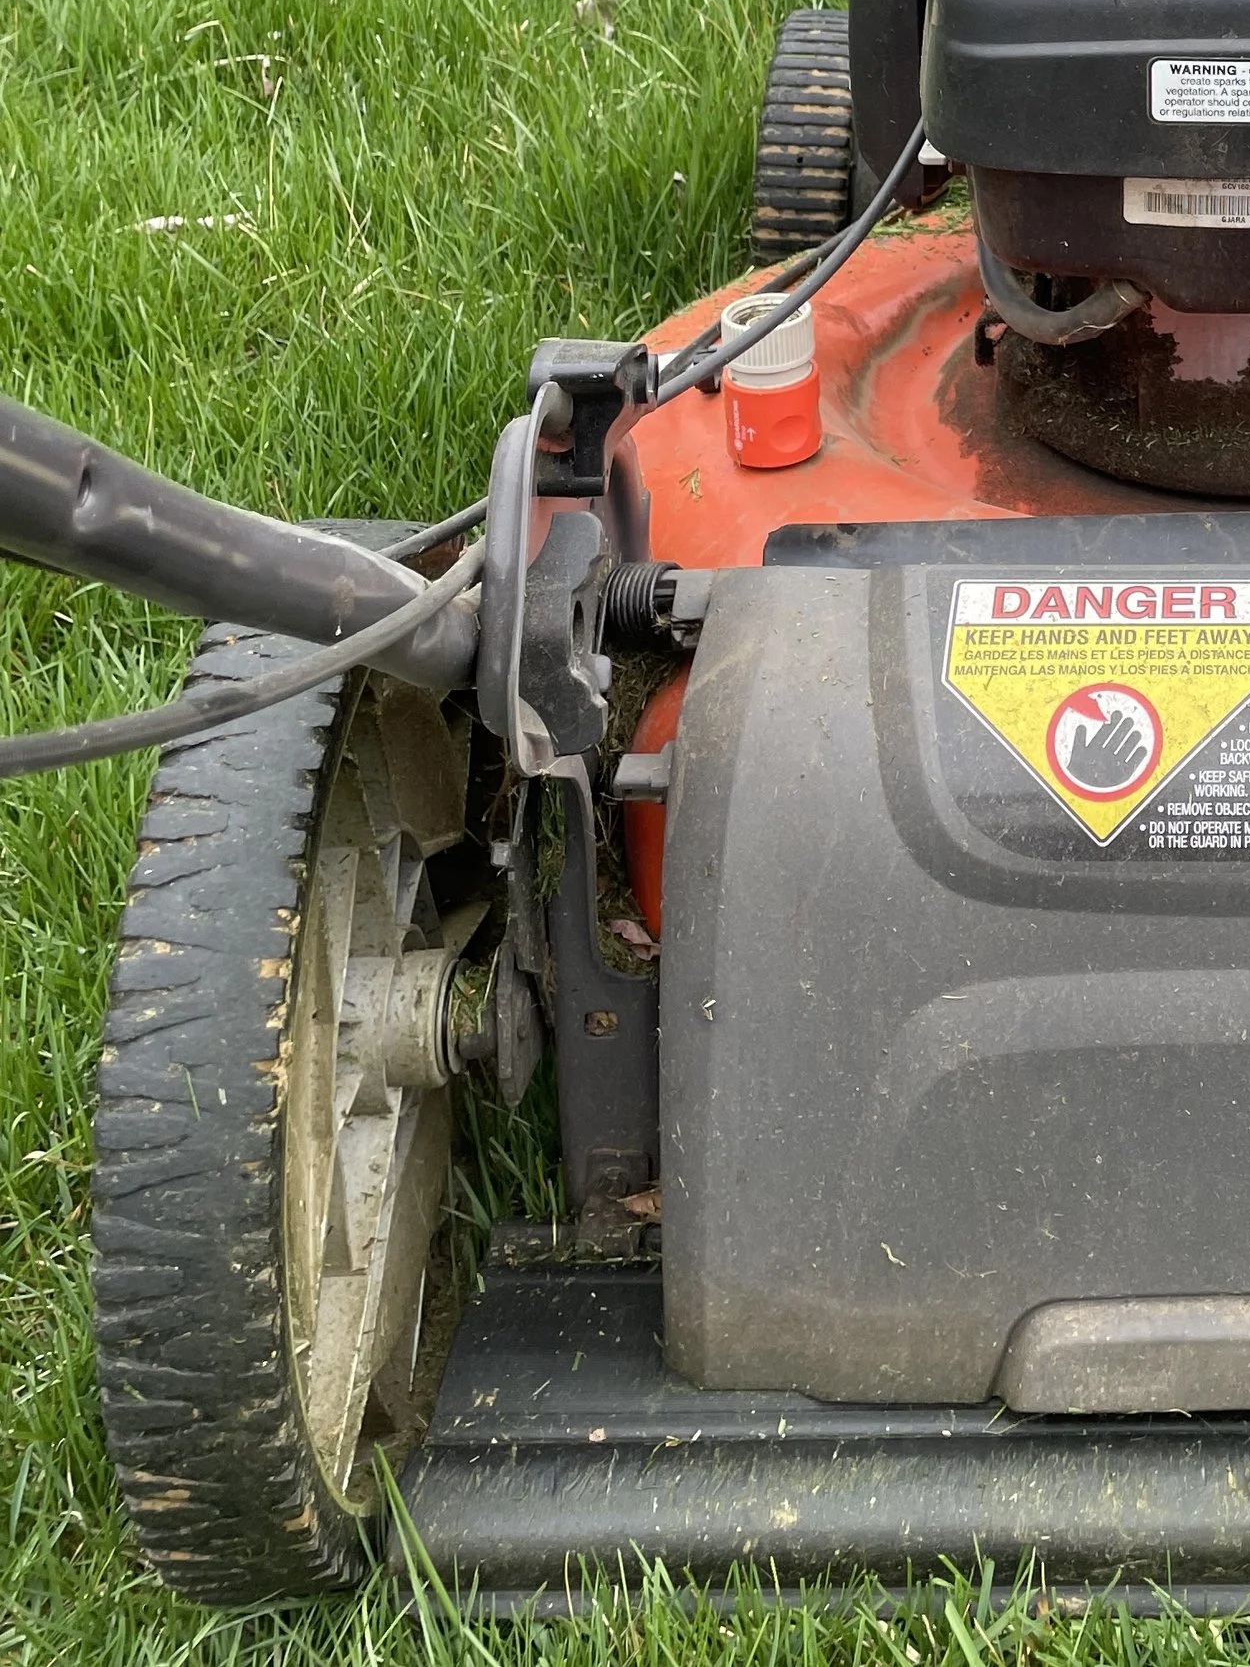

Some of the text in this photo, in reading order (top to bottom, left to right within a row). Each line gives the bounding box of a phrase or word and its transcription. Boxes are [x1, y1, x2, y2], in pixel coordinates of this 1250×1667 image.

[1170, 64, 1237, 76] WARNING
[1180, 78, 1211, 86] create
[1214, 77, 1246, 87] sparks
[1166, 88, 1218, 98] vegetation.
[1220, 88, 1228, 96] A
[1164, 98, 1205, 107] operator
[1208, 98, 1240, 107] should
[1172, 108, 1225, 118] regulations
[991, 586, 1237, 619] DANGER
[965, 629, 1014, 646] KEEP
[1020, 629, 1089, 646] HANDS
[1096, 629, 1137, 646] AND
[1144, 629, 1189, 646] FEET
[964, 650, 1017, 660] GARDEZ
[1020, 650, 1044, 660] LES
[1047, 650, 1088, 660] MAINS
[1091, 650, 1107, 660] ET
[1110, 650, 1134, 660] LES
[1138, 650, 1175, 660] PIEDS
[954, 665, 1027, 676] MANTENGA
[1030, 665, 1056, 676] LAS
[1058, 665, 1105, 676] MANOS
[1108, 665, 1118, 676] Y
[1120, 665, 1146, 676] LOS
[1150, 665, 1179, 676] PIES
[1198, 770, 1227, 784] KEEP
[1194, 784, 1248, 797] WORKING.
[1167, 803, 1213, 816] REMOVE
[1149, 821, 1165, 834] DO
[1168, 821, 1191, 834] NOT
[1194, 821, 1242, 834] OPERATE
[1148, 836, 1165, 849] OR
[1167, 836, 1188, 849] THE
[1190, 836, 1228, 849] GUARD
[1230, 836, 1242, 849] IN
